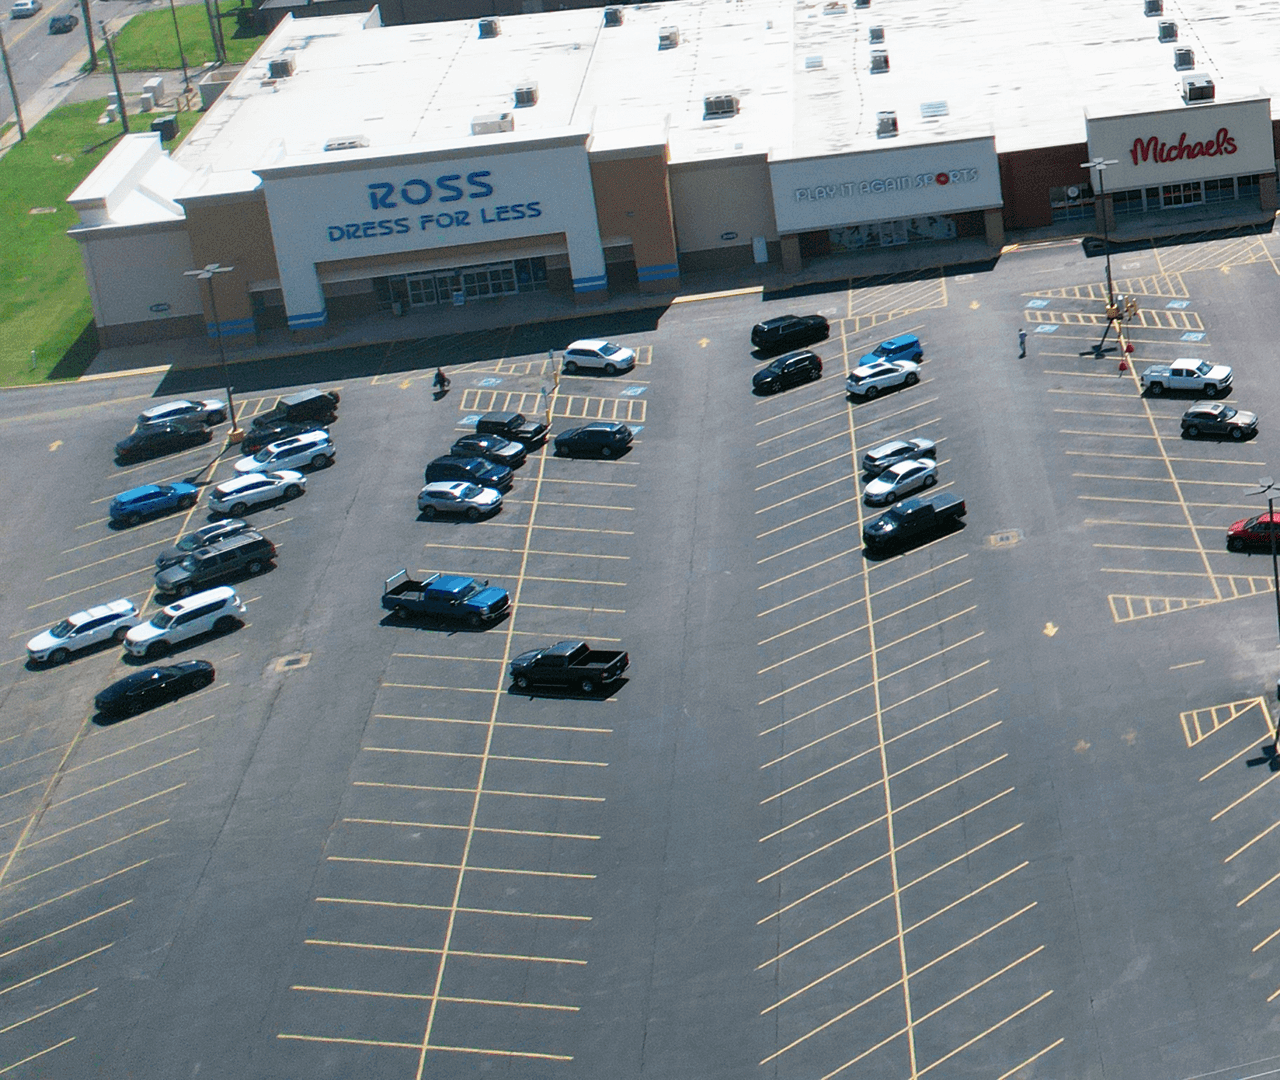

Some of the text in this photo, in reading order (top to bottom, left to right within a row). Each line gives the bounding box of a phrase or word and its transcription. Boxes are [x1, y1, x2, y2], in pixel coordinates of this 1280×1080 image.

[1130, 127, 1238, 165] Michaels
[367, 170, 494, 210] ROSS
[795, 168, 979, 202] PLAY IT AGAIN SPORTS
[328, 202, 542, 242] DRESS FOR LESS
